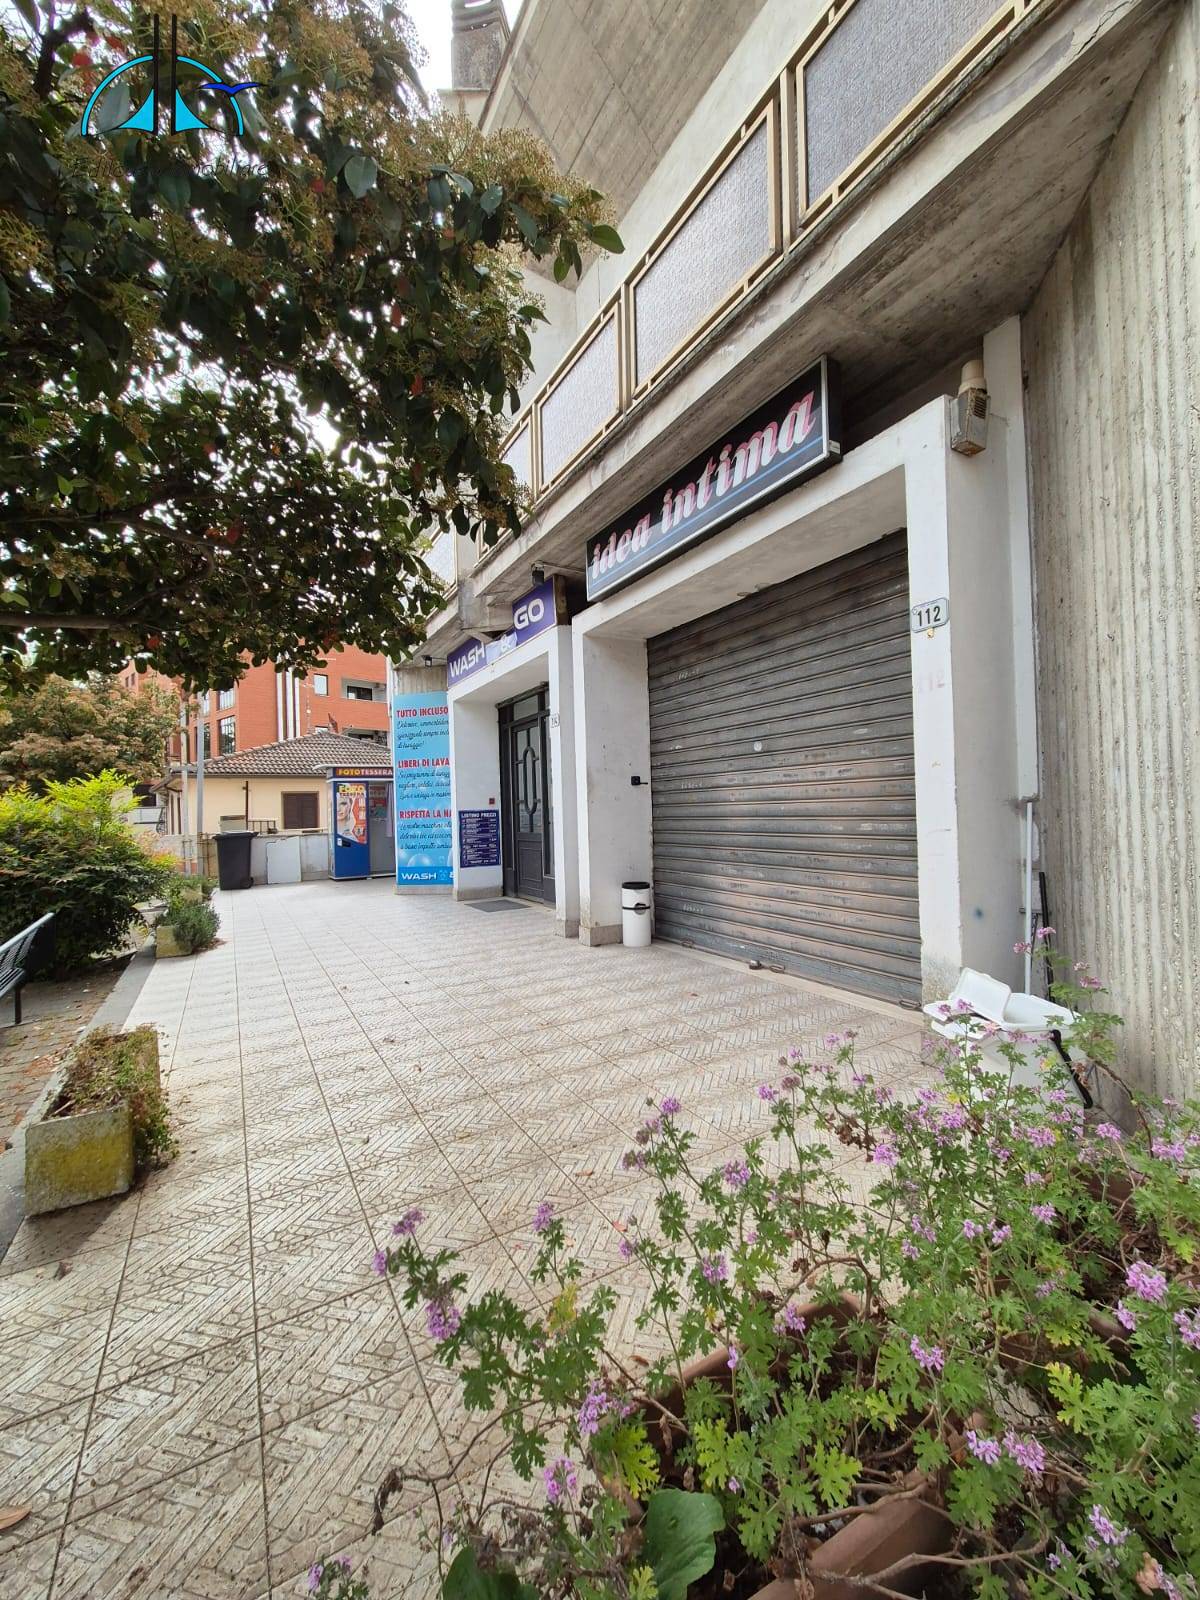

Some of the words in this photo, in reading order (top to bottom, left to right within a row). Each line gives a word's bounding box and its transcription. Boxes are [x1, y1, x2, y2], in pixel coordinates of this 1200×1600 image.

[591, 513, 651, 579] idea
[660, 390, 817, 534] intima
[917, 605, 941, 627] 112
[449, 640, 485, 678] WASH
[513, 598, 545, 630] GO
[396, 709, 418, 718] TUTTO
[419, 706, 449, 717] INCLUSO
[397, 759, 420, 769] LIBERI
[421, 758, 430, 767] DI
[338, 785, 365, 794] FOTO
[399, 809, 431, 819] RISPETTA
[432, 809, 442, 818] LA
[401, 871, 437, 881] WASH
